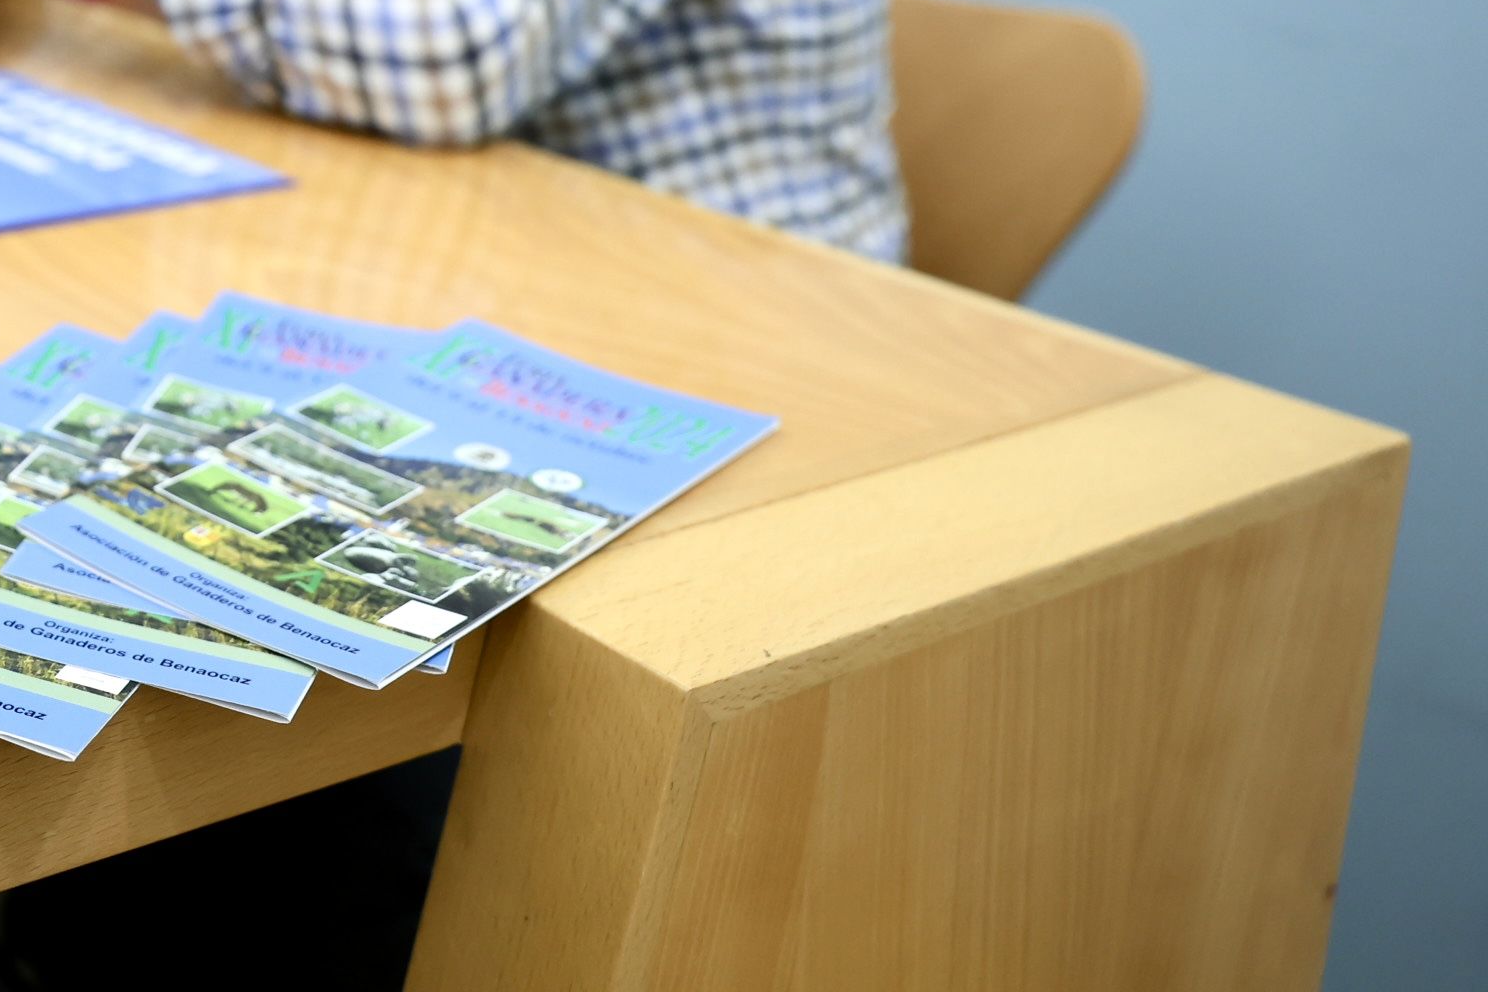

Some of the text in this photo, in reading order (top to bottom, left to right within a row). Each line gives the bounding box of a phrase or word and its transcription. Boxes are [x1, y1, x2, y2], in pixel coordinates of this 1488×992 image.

[69, 523, 361, 656] Asociación de Ganaderos de Benaocaz
[189, 571, 250, 601] Organiza:
[2, 616, 26, 633] de
[29, 621, 127, 658] Ganaderos
[132, 650, 155, 666] de
[159, 655, 252, 687] Benaocaz
[43, 618, 114, 644] Organiza:
